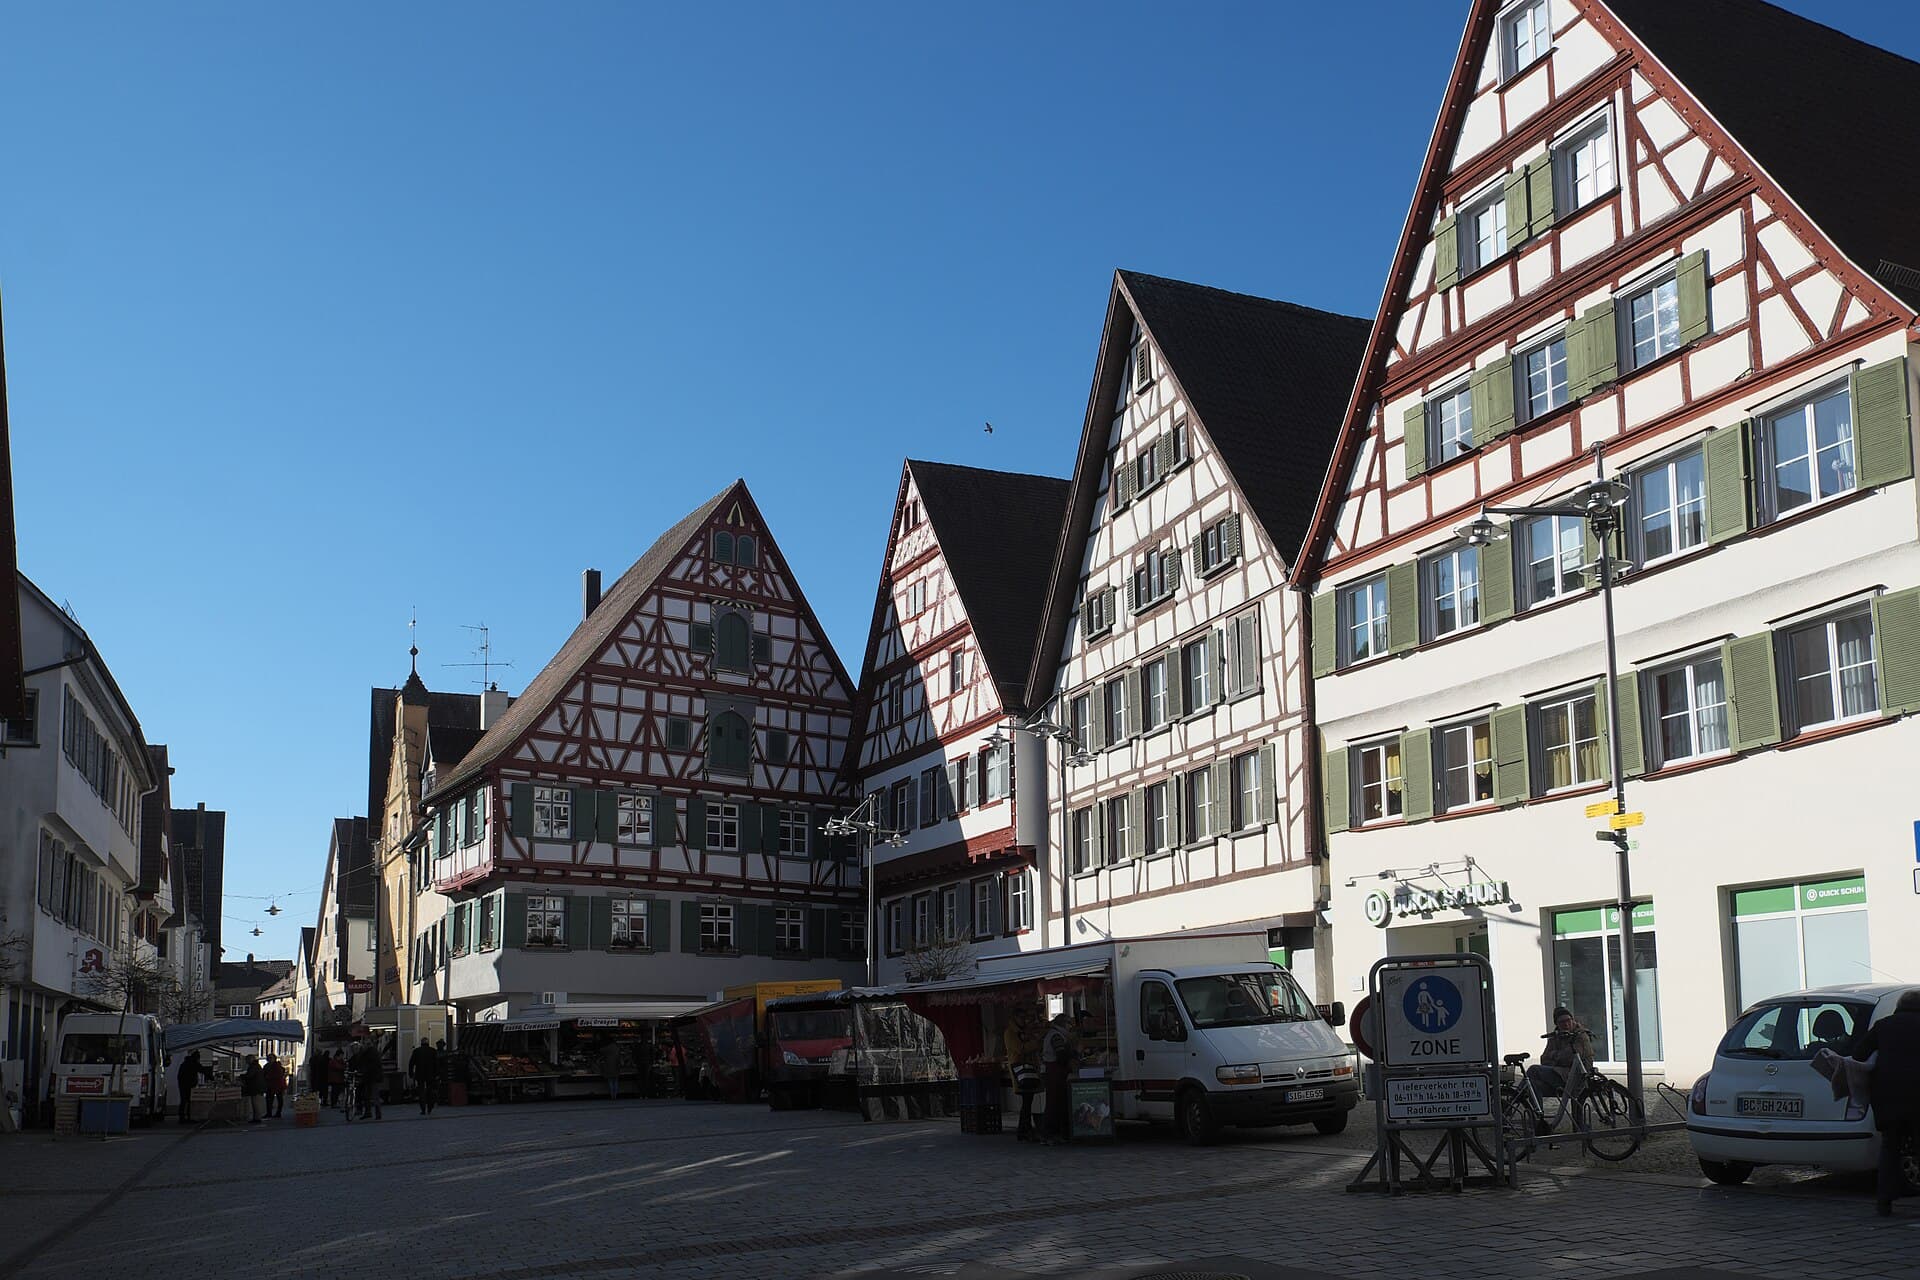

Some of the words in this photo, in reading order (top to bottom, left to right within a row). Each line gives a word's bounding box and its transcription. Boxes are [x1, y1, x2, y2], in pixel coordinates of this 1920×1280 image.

[1390, 892, 1439, 913] QUICK
[1440, 882, 1508, 908] SCHUH
[1819, 889, 1839, 898] QUICK
[1840, 886, 1864, 895] SCHUH
[1410, 1039, 1461, 1056] ZONE
[1397, 1081, 1457, 1091] Lieferverkehr
[1462, 1079, 1477, 1088] frei
[1407, 1105, 1451, 1115] Radfahrer
[1455, 1103, 1471, 1112] frei
[1743, 1100, 1756, 1111] BC
[1762, 1100, 1775, 1112] GH
[1776, 1100, 1800, 1113] 2411
